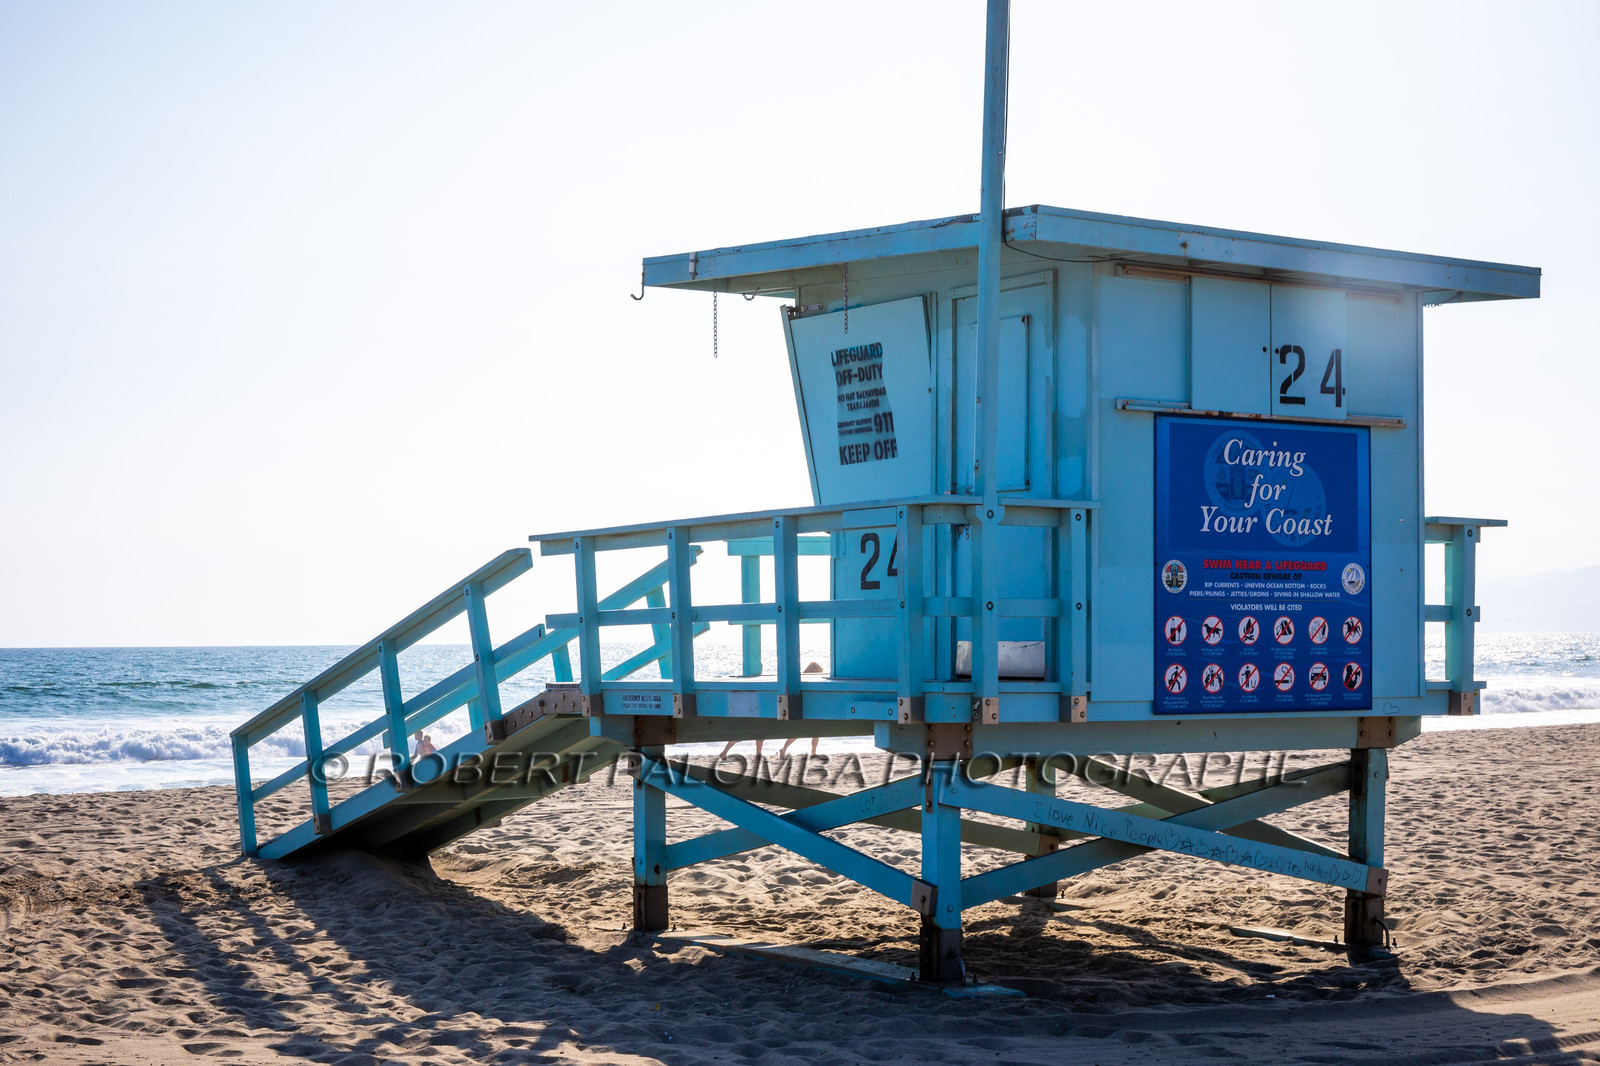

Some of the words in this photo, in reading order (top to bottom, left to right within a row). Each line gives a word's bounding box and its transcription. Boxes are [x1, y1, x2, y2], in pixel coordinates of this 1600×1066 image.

[831, 342, 882, 366] LIFEGUARD
[835, 363, 882, 386] OFF-DUTY
[1279, 345, 1346, 408] 24
[845, 391, 856, 401] HAY
[855, 387, 887, 400] SALVAVIDAS
[873, 411, 894, 433] 911
[839, 442, 870, 465] KEEP
[873, 438, 898, 460] OFF
[1223, 438, 1306, 477] Caring
[1244, 473, 1287, 509] for
[1200, 505, 1258, 533] Your
[1265, 508, 1333, 536] Coast
[1203, 559, 1232, 569] SWIM
[1235, 560, 1262, 570] NEAR
[1264, 560, 1272, 570] A
[1275, 560, 1327, 571] LIFEGUARD
[1230, 572, 1261, 580] CAUTION
[1262, 572, 1291, 580] BEWARE
[1292, 573, 1303, 581] OF
[1230, 603, 1263, 611] VIOLATORS
[1032, 801, 1044, 819] I
[1047, 804, 1075, 827] love
[1083, 811, 1117, 839] Nice
[1124, 818, 1164, 847] People
